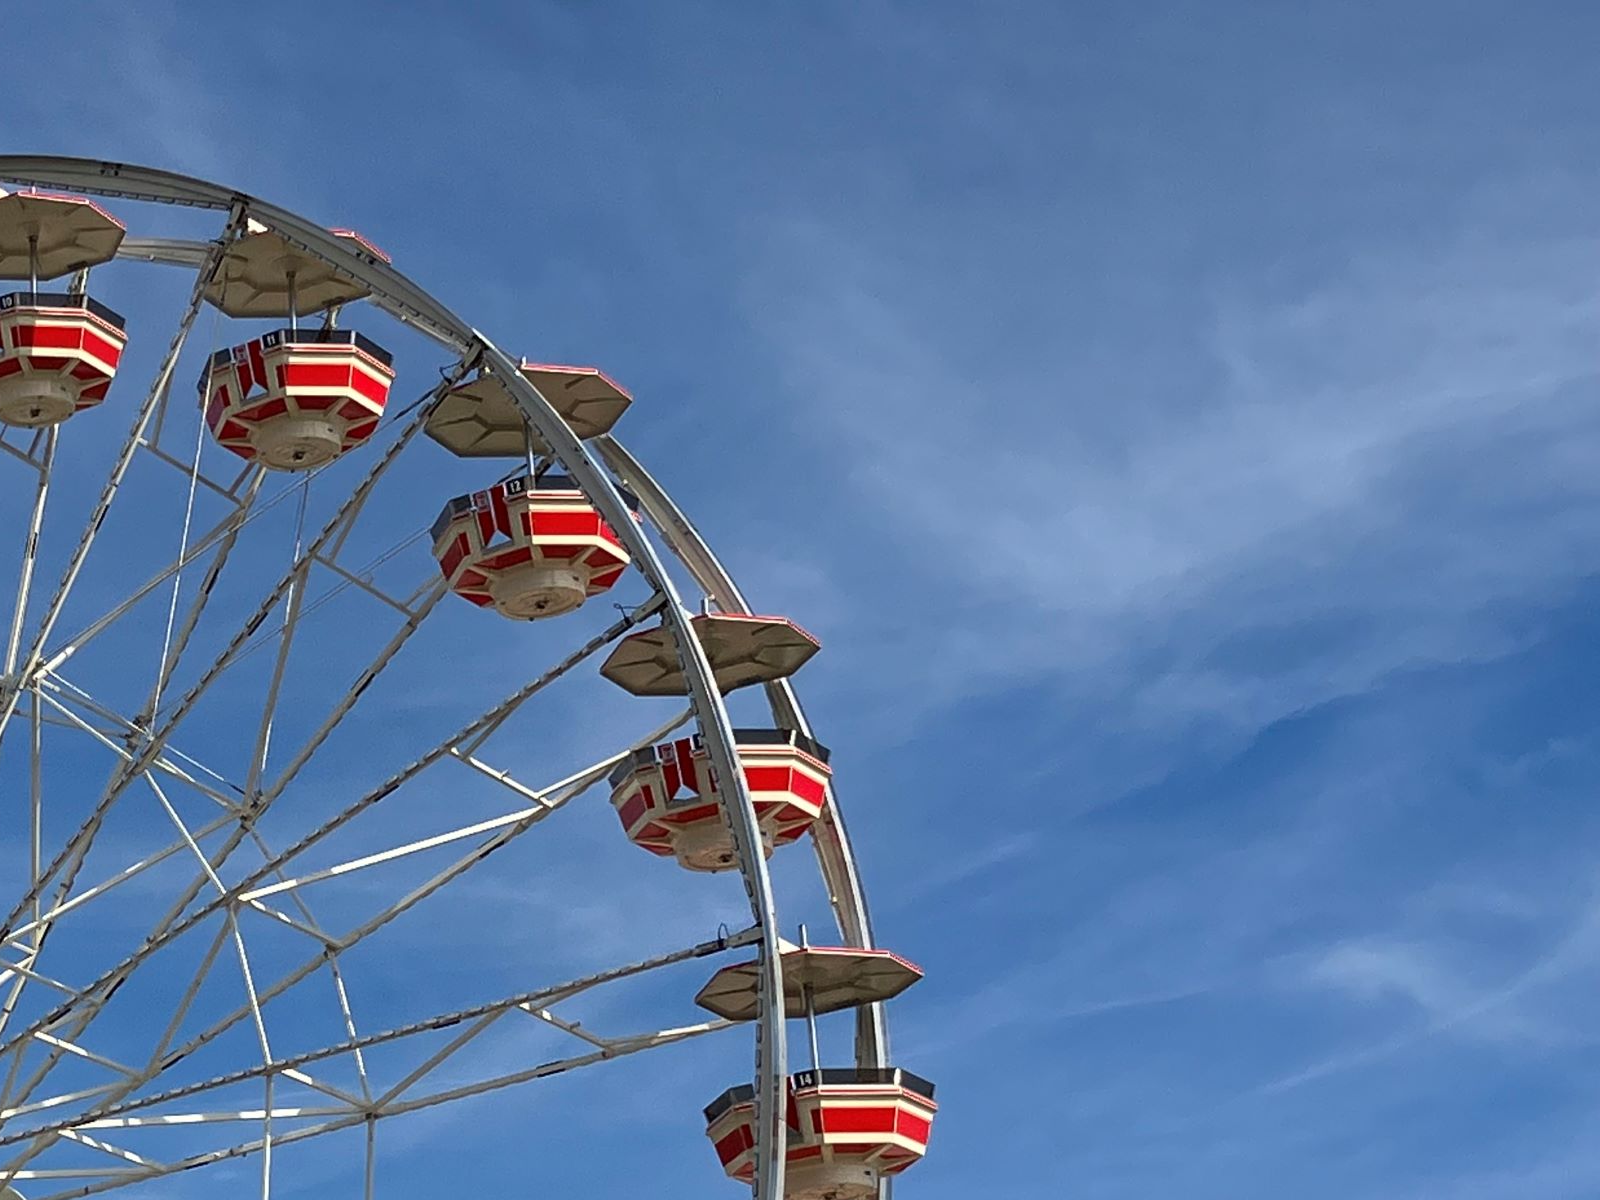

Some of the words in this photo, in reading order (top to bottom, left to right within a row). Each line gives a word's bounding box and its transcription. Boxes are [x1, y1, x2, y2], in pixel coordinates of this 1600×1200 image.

[1, 296, 12, 308] 10
[266, 335, 276, 346] 11
[510, 481, 521, 493] 12
[800, 1074, 812, 1086] 14
